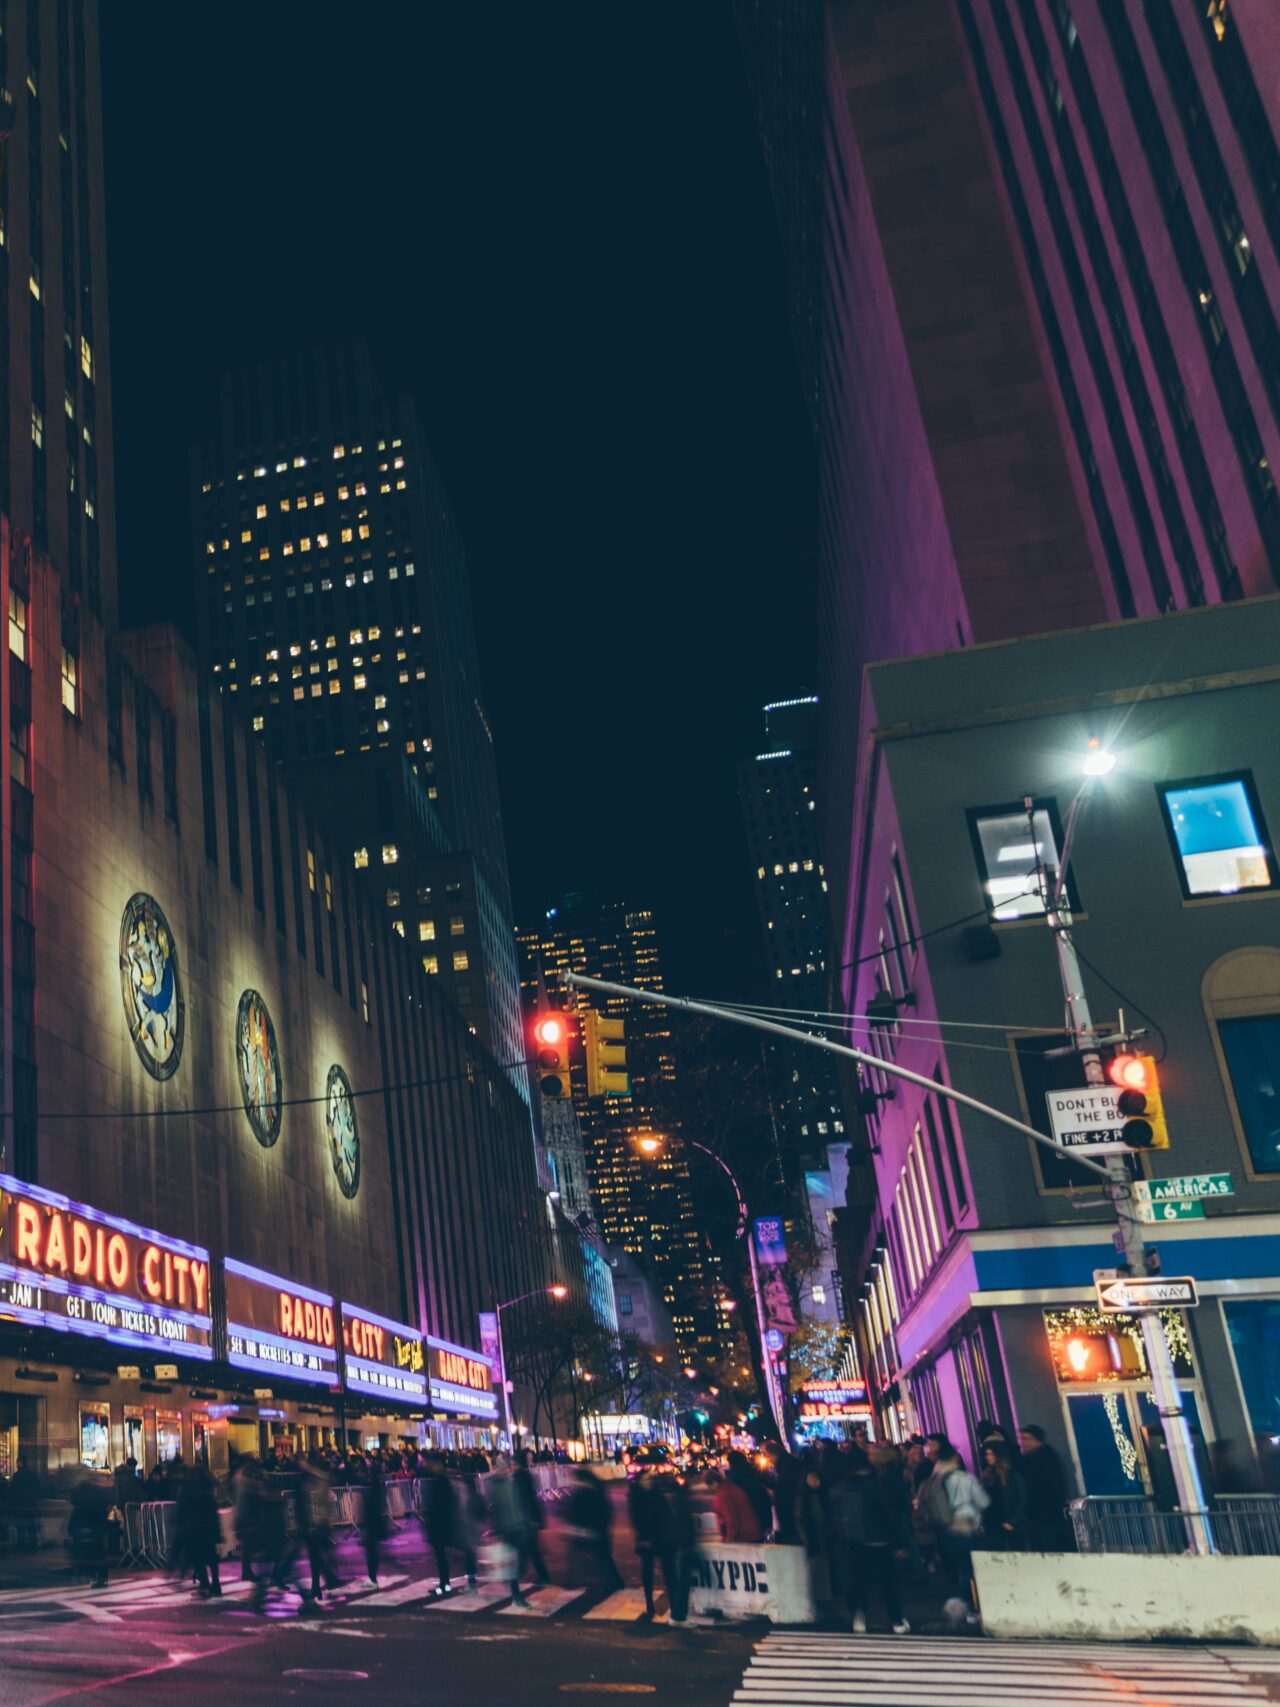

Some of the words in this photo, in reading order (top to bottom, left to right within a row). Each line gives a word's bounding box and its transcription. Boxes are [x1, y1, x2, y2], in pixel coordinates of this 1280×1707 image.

[1056, 1098, 1095, 1112] DON'T
[1076, 1110, 1102, 1123] THE
[1106, 1109, 1125, 1121] BO
[1064, 1131, 1089, 1145] FINE
[1155, 1180, 1229, 1199] AMERICAS
[1164, 1203, 1178, 1220] 6
[1180, 1201, 1193, 1211] AV
[756, 1221, 779, 1231] TOP
[16, 1200, 130, 1288] RADIO
[143, 1246, 207, 1310] CITY
[9, 1282, 33, 1309] JAN
[1110, 1289, 1137, 1300] ONE
[1156, 1286, 1185, 1297] WAY
[66, 1294, 86, 1319] GET
[90, 1302, 117, 1326] YOUR
[121, 1308, 156, 1335] TICKETS
[158, 1317, 188, 1341] TODAY!
[279, 1292, 335, 1347] RADIO
[350, 1319, 385, 1362] CITY
[231, 1335, 243, 1354] SEE
[246, 1339, 258, 1358] THE
[258, 1343, 291, 1365] ROCKETTES
[437, 1349, 468, 1386] RADIO
[468, 1360, 489, 1391] CITY
[803, 1403, 843, 1416] NBC
[699, 1560, 758, 1592] NYPD
